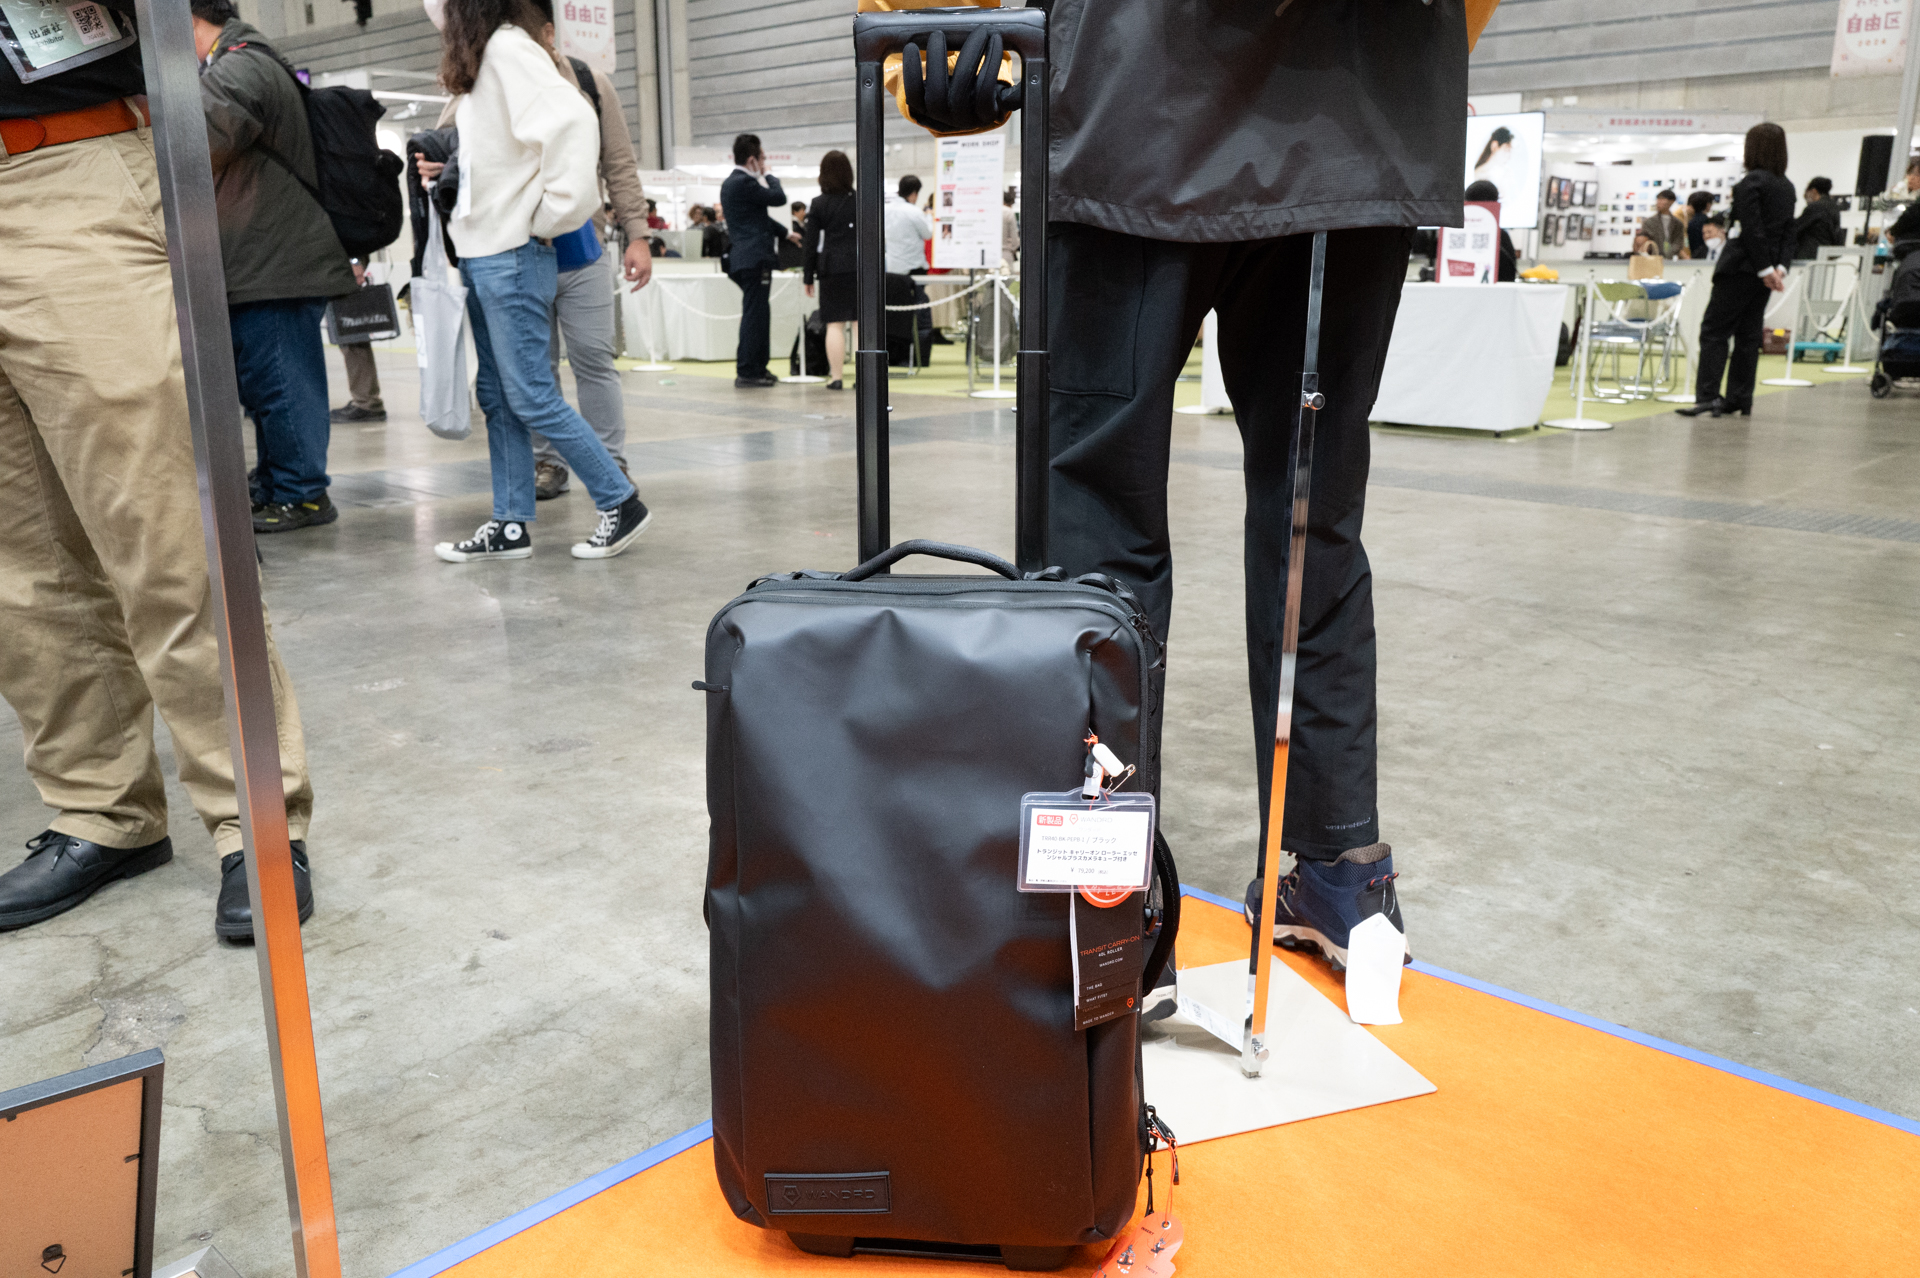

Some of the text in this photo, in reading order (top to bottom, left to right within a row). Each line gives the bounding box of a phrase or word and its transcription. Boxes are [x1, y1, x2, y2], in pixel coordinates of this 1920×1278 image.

[564, 0, 607, 25] 自由区
[1846, 11, 1902, 33] 自由区
[1038, 815, 1062, 826] 新製品
[1080, 935, 1140, 957] TRANSIT CARRY-ON
[1107, 946, 1123, 955] ROLLER
